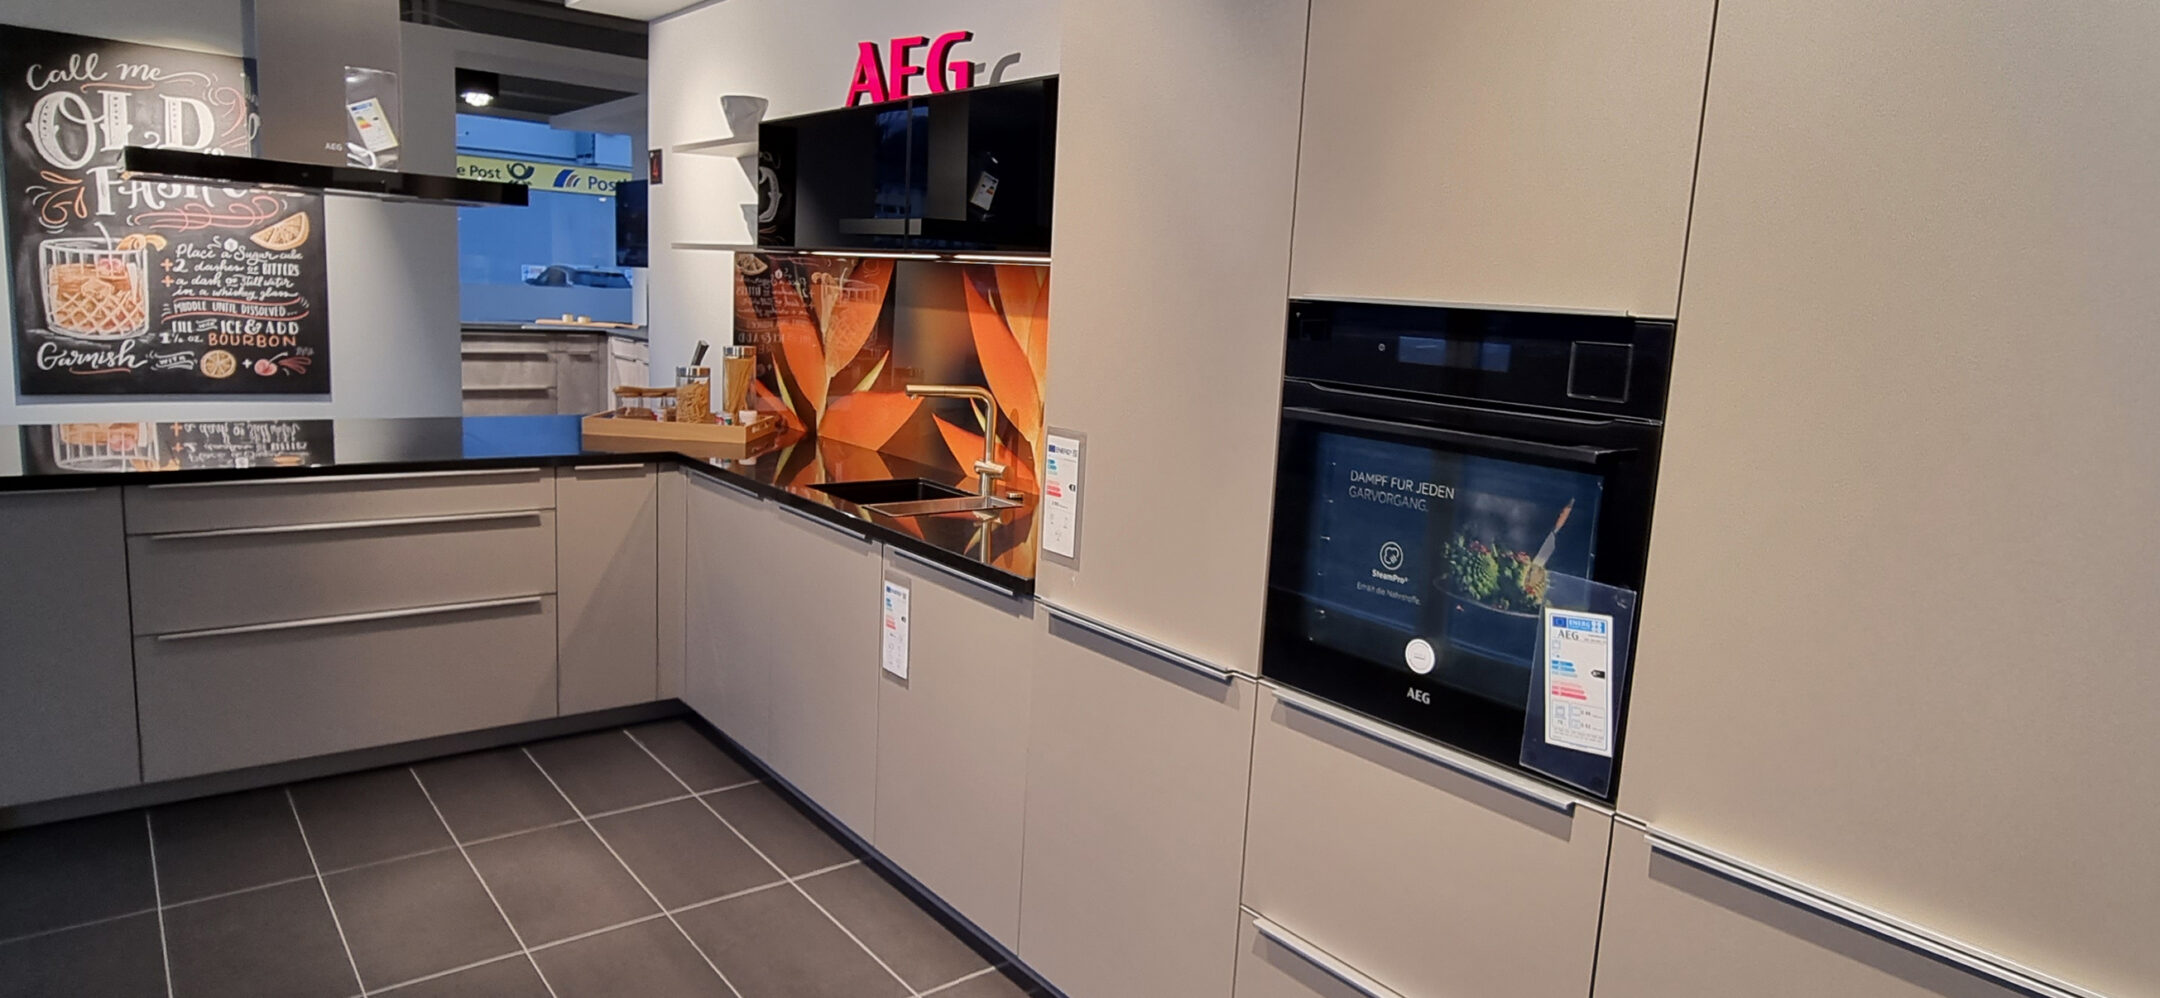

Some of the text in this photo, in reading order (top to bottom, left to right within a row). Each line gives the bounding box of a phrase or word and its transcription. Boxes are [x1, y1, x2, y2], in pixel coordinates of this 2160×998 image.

[27, 53, 107, 91] Call
[845, 31, 973, 108] AEG
[25, 90, 215, 170] OLD
[325, 142, 343, 151] AEG
[470, 164, 502, 180] Post
[588, 175, 626, 192] Pos
[175, 243, 217, 260] Place
[221, 251, 232, 260] a
[234, 245, 279, 265] Sugar
[173, 258, 189, 273] 2
[194, 260, 244, 273] dashes
[262, 262, 300, 277] BITTERS
[175, 277, 187, 286] a
[191, 274, 223, 287] dash
[172, 287, 196, 297] in
[199, 289, 210, 297] a
[260, 287, 299, 300] glass
[220, 320, 242, 335] ICE
[244, 318, 263, 336] &
[265, 321, 300, 336] ADD
[208, 332, 298, 349] BOURBON
[37, 339, 148, 371] Garnish
[1349, 469, 1388, 487] DAMPF
[1415, 482, 1455, 500] JEDEN
[1557, 629, 1579, 641] AEG
[1406, 687, 1431, 705] AEG
